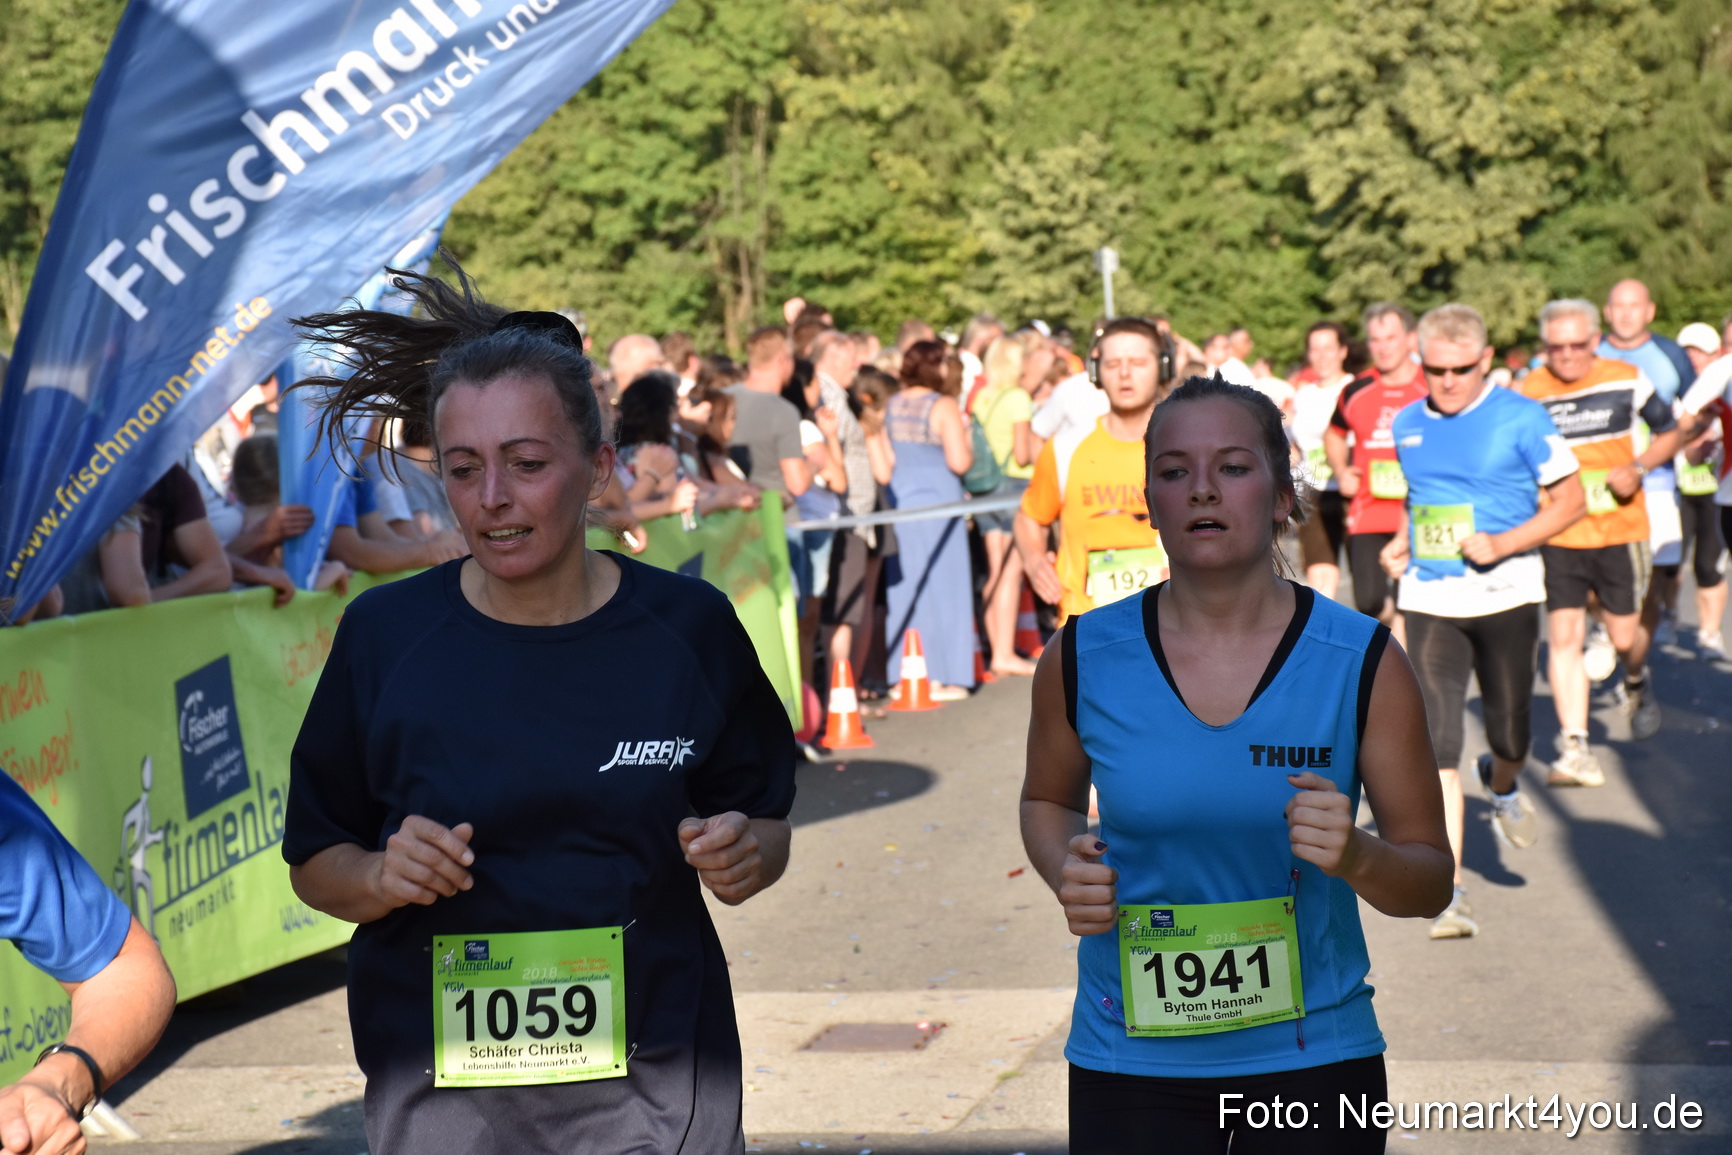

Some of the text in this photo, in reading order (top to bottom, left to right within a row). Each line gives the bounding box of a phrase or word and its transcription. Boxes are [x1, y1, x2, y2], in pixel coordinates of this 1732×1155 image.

[381, 45, 490, 140] Druck
[5, 296, 272, 579] www.frischmann-net.de
[187, 704, 230, 744] Fischer
[644, 758, 669, 766] SERVICE
[1249, 744, 1332, 769] THULE
[163, 769, 287, 902] firmenla
[169, 876, 236, 938] neumarkt
[1141, 925, 1197, 937] firmenlauf
[1206, 932, 1238, 945] 2018
[454, 957, 514, 972] firmenlauf
[522, 967, 558, 981] 2018
[1144, 945, 1270, 999] 1941
[455, 984, 597, 1042] 1059
[1164, 994, 1263, 1015] Bytom Hannah
[1186, 1013, 1212, 1022] Thule
[1214, 1010, 1242, 1020] GmbH
[469, 1042, 583, 1059] Schäfer Christa
[463, 1056, 590, 1070] Lebenshilfe Neumarkt e.V.
